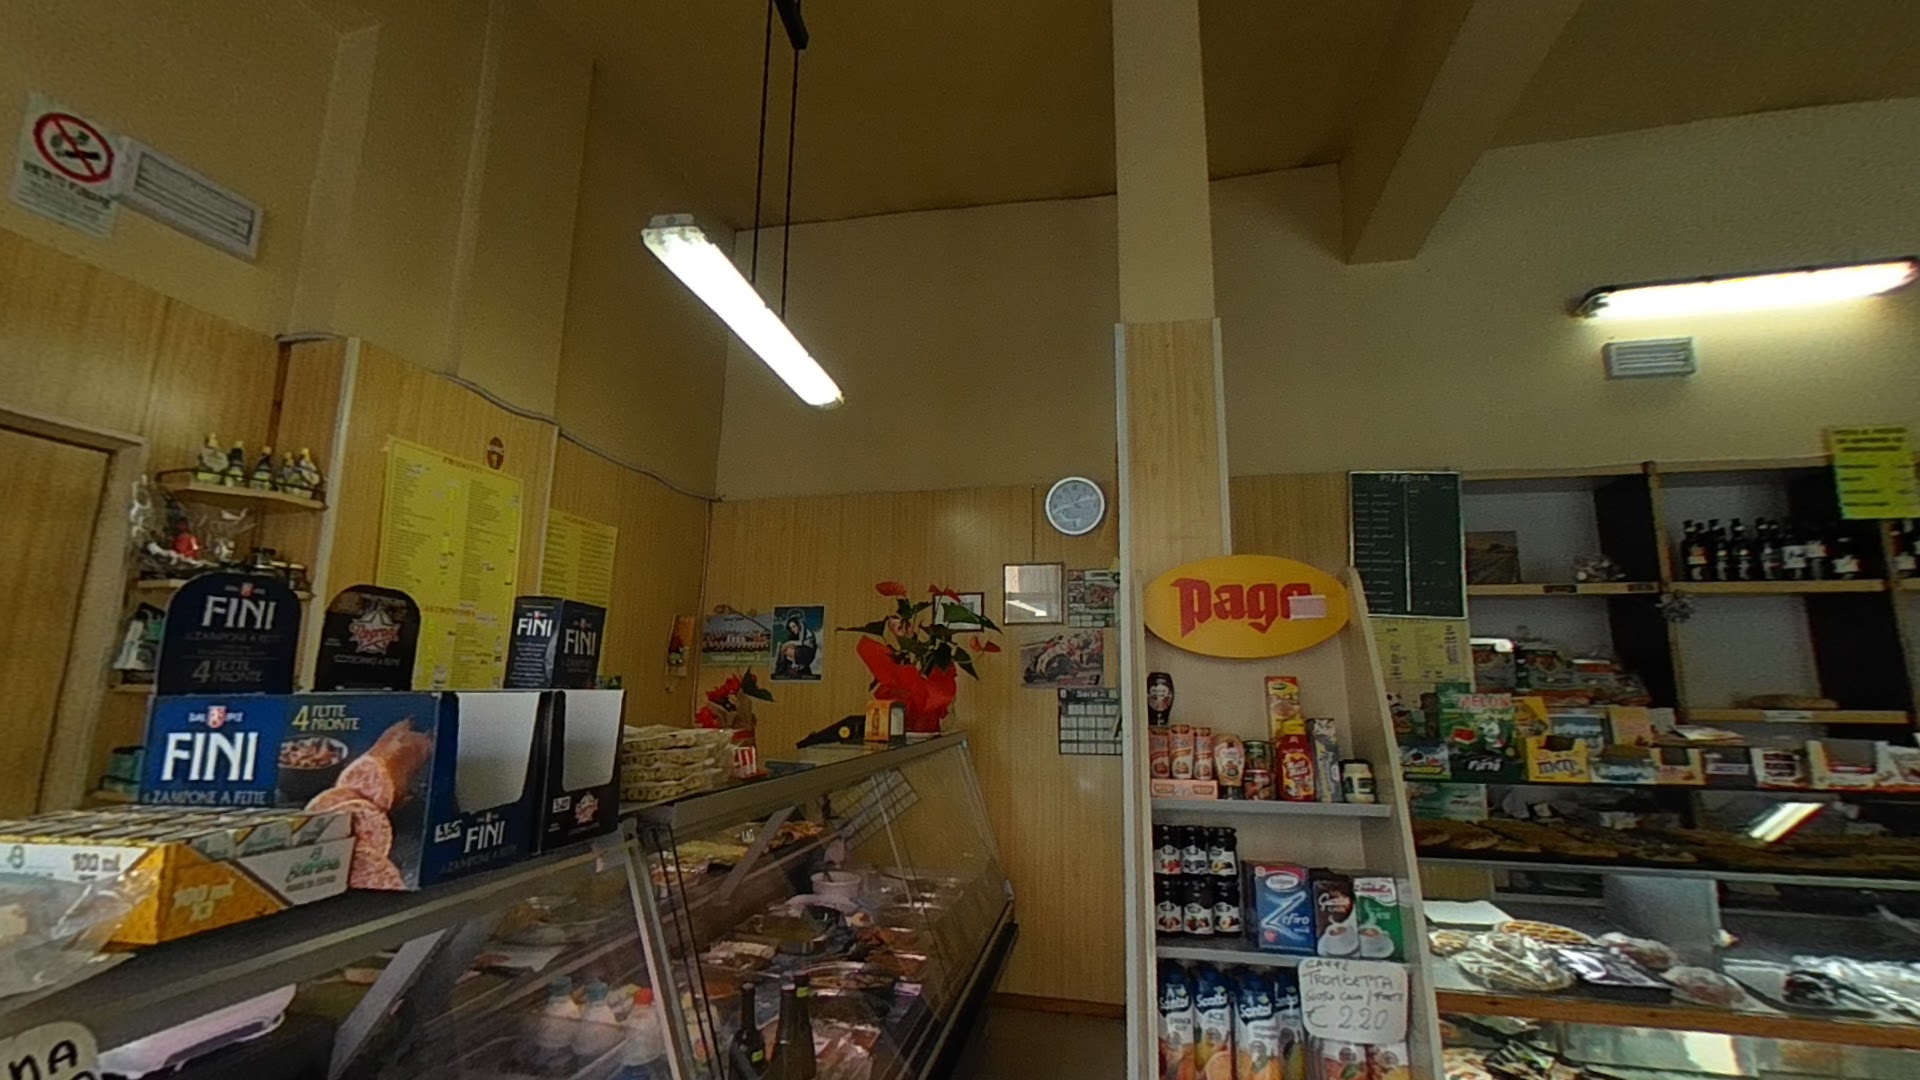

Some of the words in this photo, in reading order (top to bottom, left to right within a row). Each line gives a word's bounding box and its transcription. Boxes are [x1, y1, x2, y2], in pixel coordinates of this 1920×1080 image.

[201, 595, 278, 631] FINI
[516, 618, 553, 638] FINI
[563, 628, 597, 656] FINI
[191, 660, 212, 684] 4
[291, 704, 310, 731] 4
[312, 704, 348, 718] FETTE
[311, 717, 361, 731] PRONTE
[160, 731, 260, 782] FINI
[219, 791, 232, 805] A
[463, 820, 506, 854] FINI
